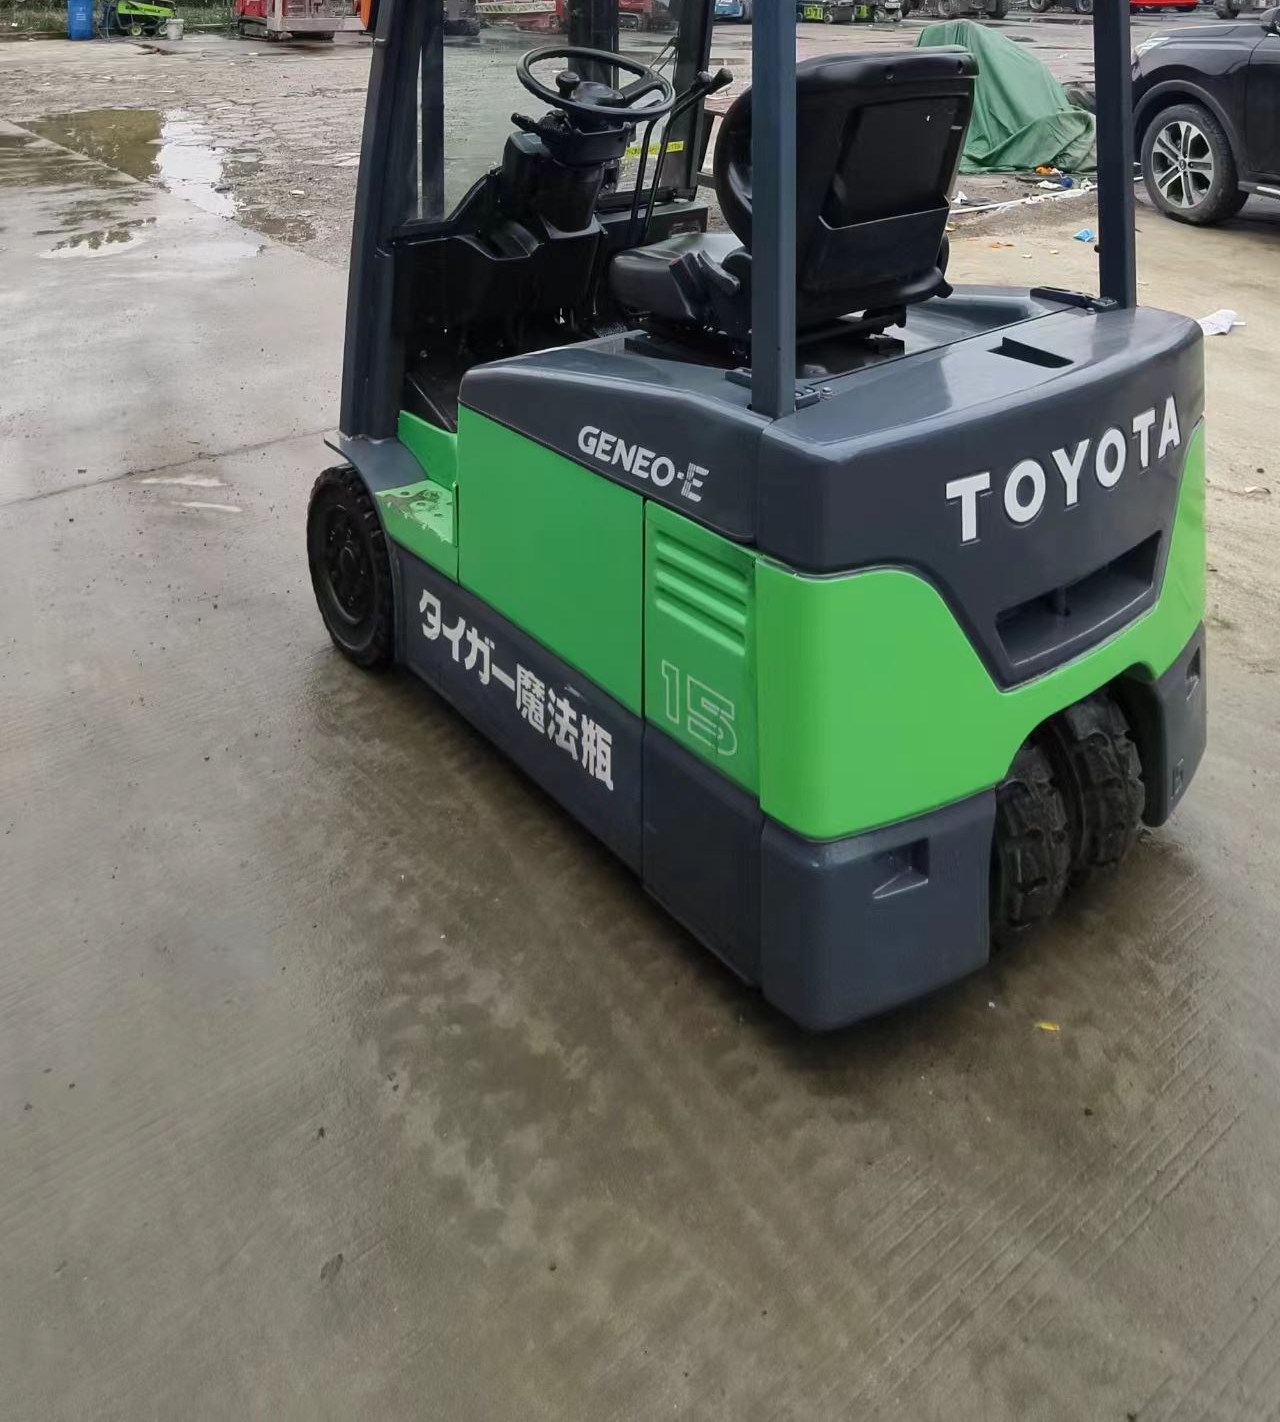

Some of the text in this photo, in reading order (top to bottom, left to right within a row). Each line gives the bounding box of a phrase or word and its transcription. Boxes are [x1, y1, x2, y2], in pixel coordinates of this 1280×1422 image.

[945, 394, 1182, 544] TOYOTA
[419, 588, 614, 791] タイガー魔法瓶
[661, 658, 738, 756] 15
